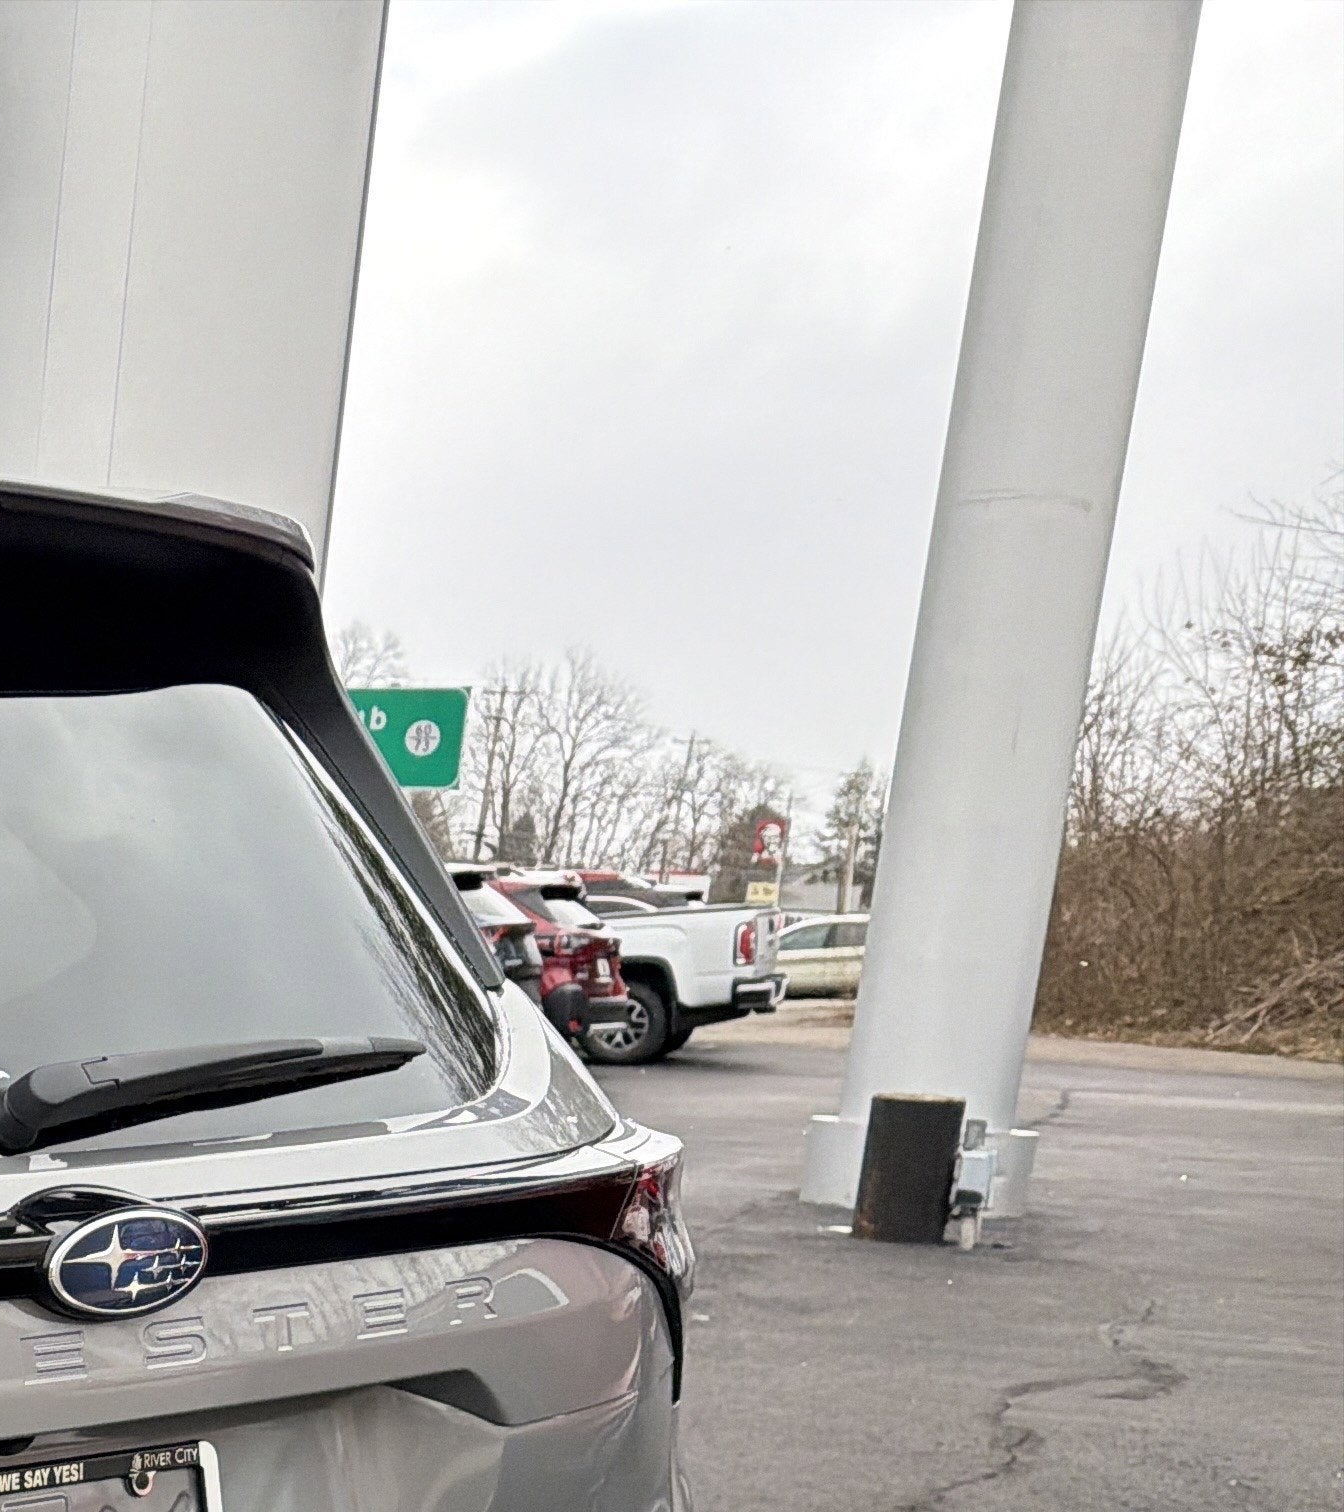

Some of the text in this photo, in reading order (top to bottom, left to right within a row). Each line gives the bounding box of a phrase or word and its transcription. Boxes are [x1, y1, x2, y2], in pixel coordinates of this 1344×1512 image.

[143, 1448, 198, 1468] RIVER CITY
[23, 1467, 51, 1489] SAY
[52, 1462, 84, 1485] YES!
